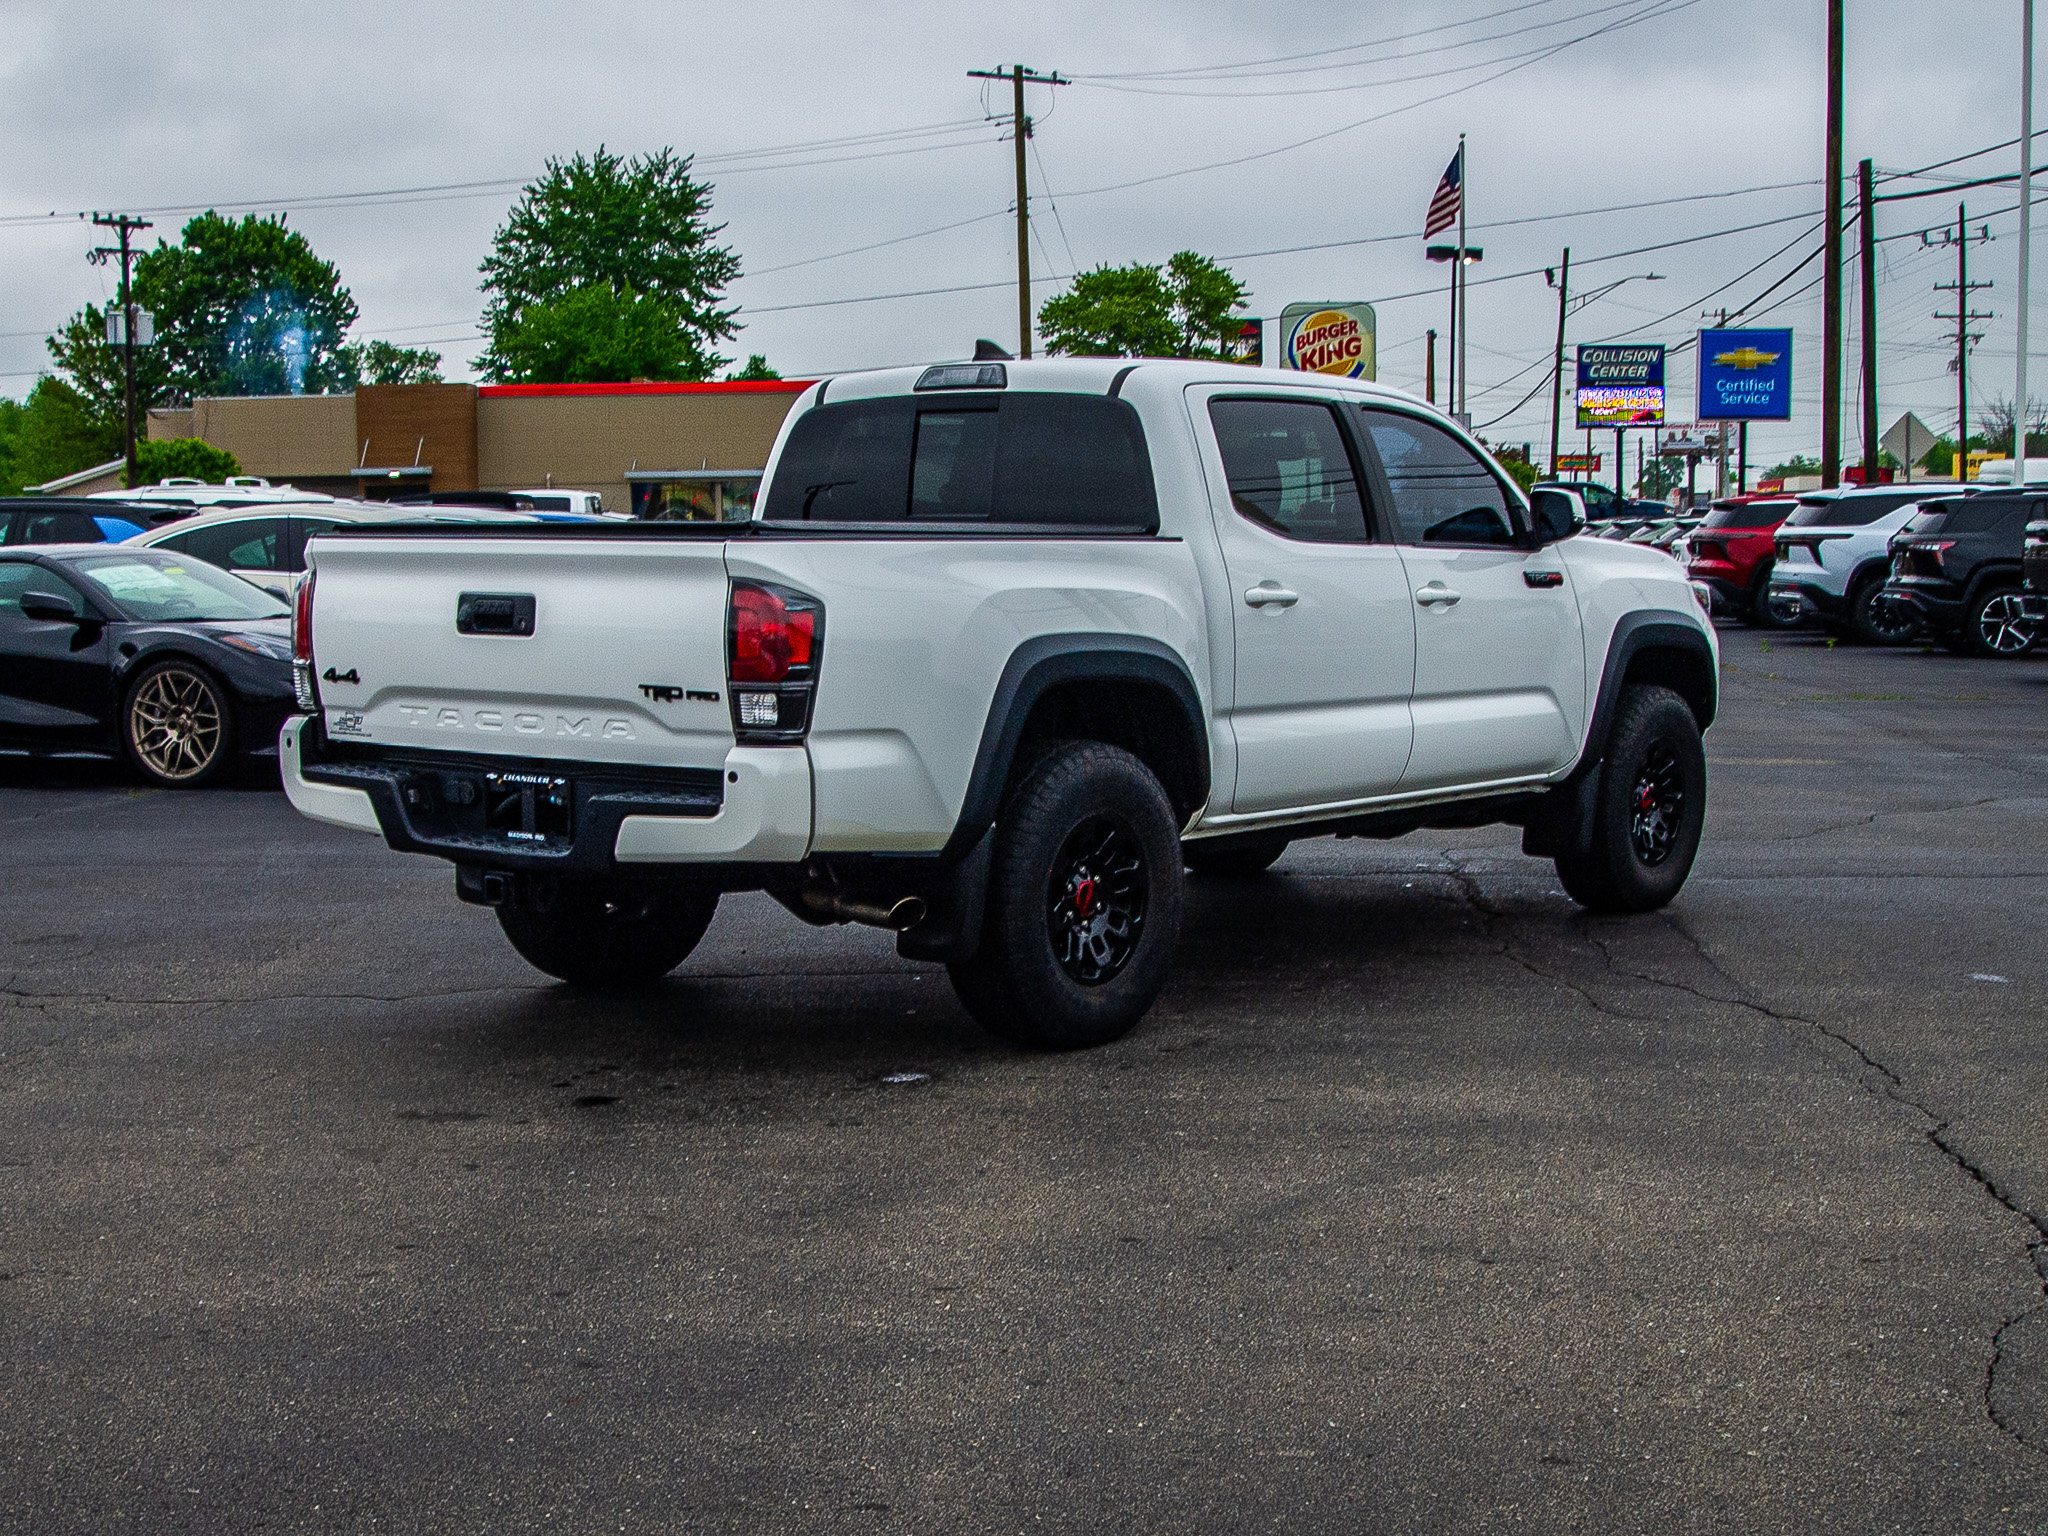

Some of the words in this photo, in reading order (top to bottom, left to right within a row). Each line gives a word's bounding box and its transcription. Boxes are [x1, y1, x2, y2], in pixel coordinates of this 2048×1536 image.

[1296, 320, 1359, 352] BURGER
[1300, 336, 1362, 372] KING
[1582, 349, 1659, 363] COLLISION
[1589, 365, 1649, 378] CENTER
[1716, 378, 1775, 392] Certified
[1720, 391, 1770, 405] Service
[638, 683, 684, 703] TRD
[399, 703, 637, 741] TACOMA
[503, 774, 550, 784] CHANDLER
